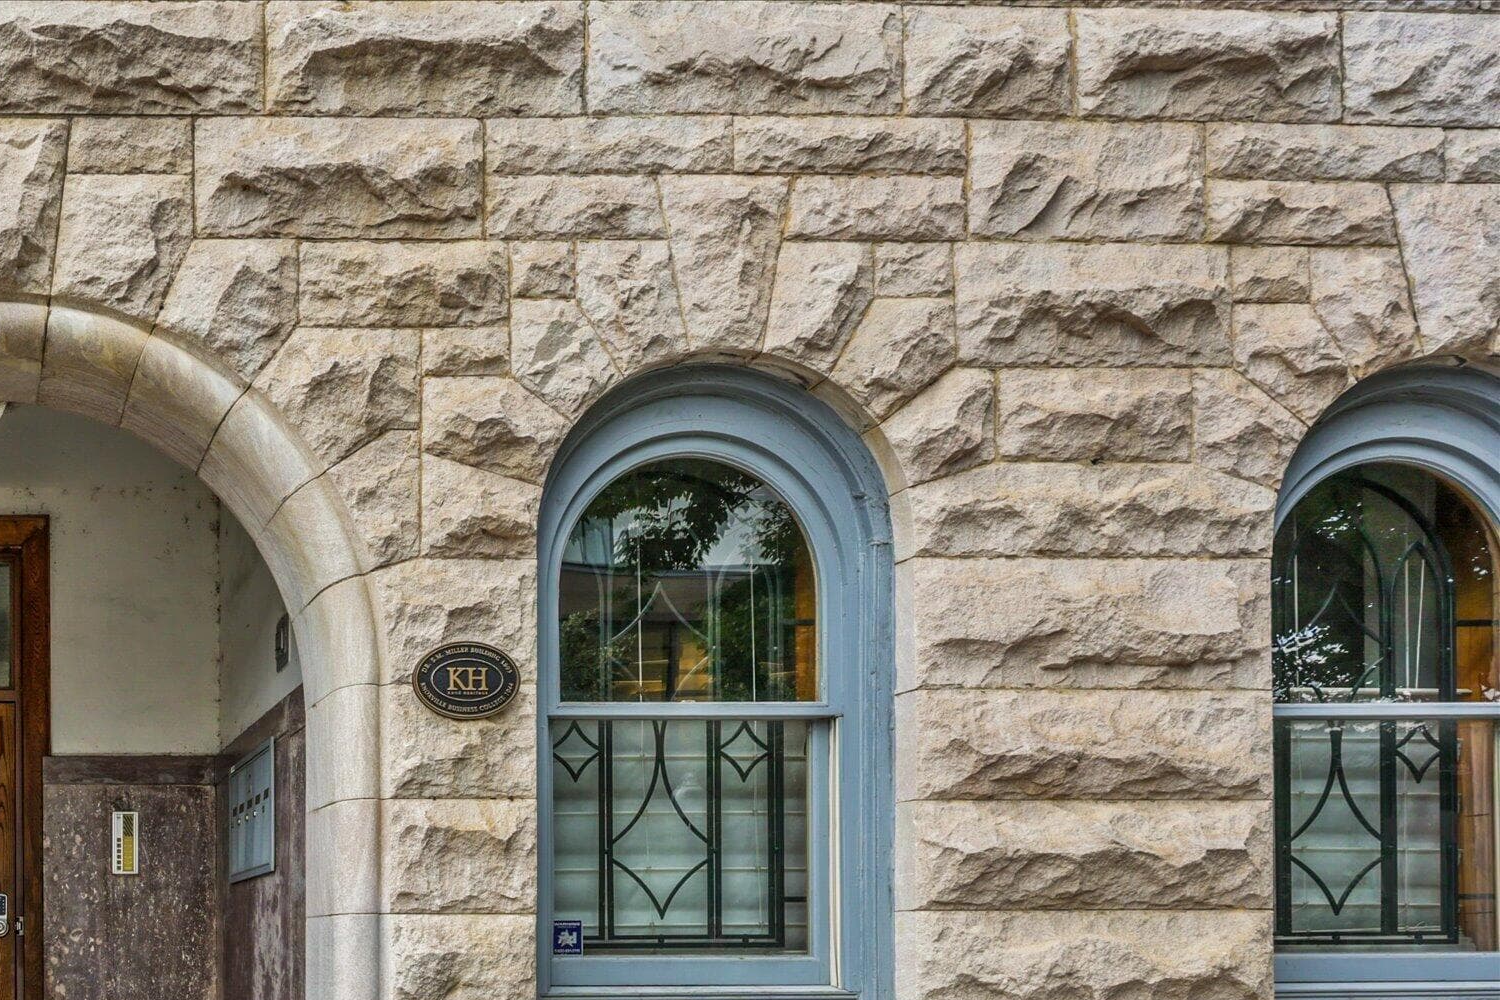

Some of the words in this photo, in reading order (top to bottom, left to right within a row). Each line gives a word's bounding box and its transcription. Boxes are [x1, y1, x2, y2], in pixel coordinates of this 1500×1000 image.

[445, 646, 469, 656] MILLER
[470, 647, 501, 661] BUILDING
[446, 667, 489, 691] KH
[420, 682, 447, 707] KNOXVILLE
[448, 704, 479, 713] BUSINESS
